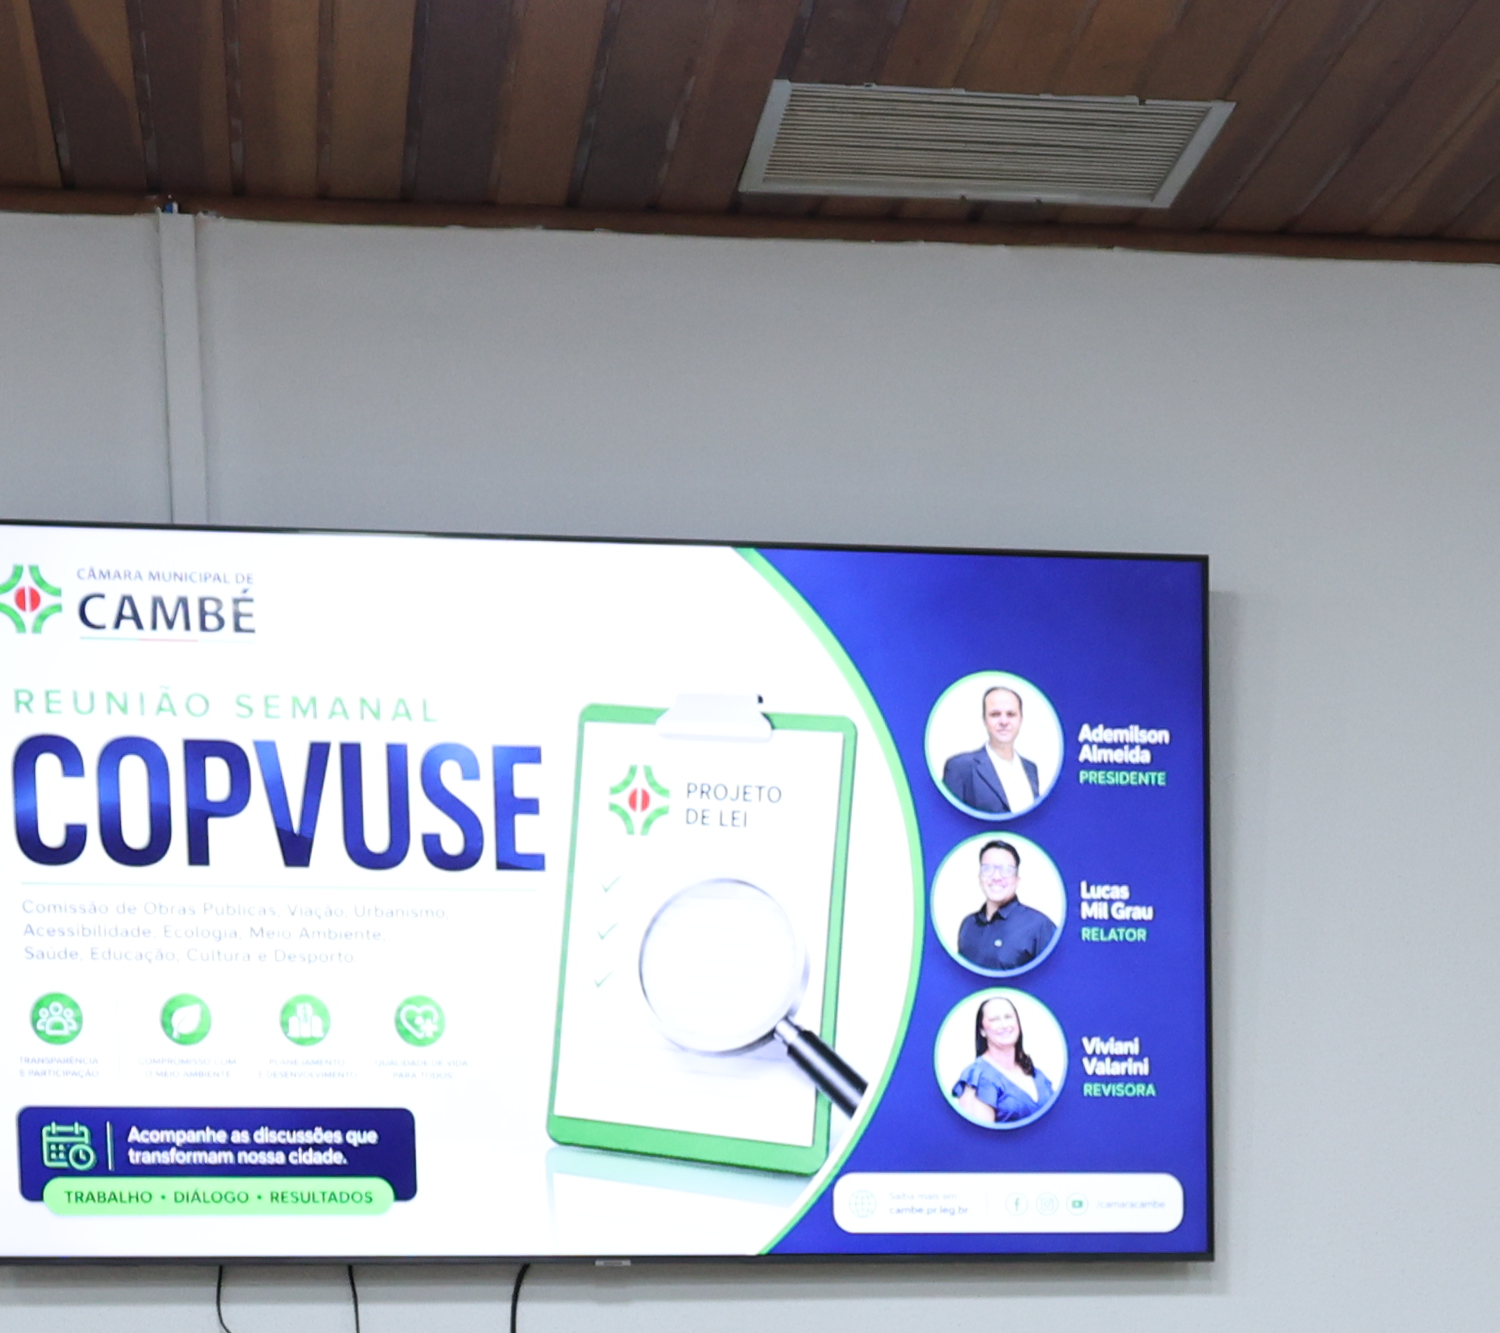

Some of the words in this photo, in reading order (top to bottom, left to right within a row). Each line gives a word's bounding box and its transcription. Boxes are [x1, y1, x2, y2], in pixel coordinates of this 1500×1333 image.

[77, 567, 143, 581] CÂMARA
[149, 571, 228, 583] MUNICIPAL
[236, 573, 253, 584] DE
[78, 589, 255, 633] CAMBÉ
[13, 685, 210, 718] REUNIÃO
[235, 694, 436, 722] SEMANAL
[1078, 723, 1170, 744] Ademilson
[1078, 744, 1151, 764] Almeida
[1079, 770, 1166, 786] PRESIDENTE
[687, 783, 782, 803] PROJETO
[12, 734, 545, 872] COPVUSE
[686, 808, 709, 825] DE
[720, 810, 747, 827] LEI
[1080, 881, 1130, 900] Lucas
[116, 902, 137, 914] de
[144, 902, 195, 915] Obras
[1081, 901, 1109, 920] Mil
[1110, 901, 1154, 920] Grau
[1081, 927, 1148, 942] RELATOR
[187, 948, 250, 961] Cultura
[257, 952, 268, 963] e
[1082, 1037, 1140, 1056] Viviani
[1082, 1057, 1149, 1075] Valarini
[1083, 1082, 1157, 1097] REVISORA
[128, 1126, 228, 1147] Acompanhe
[231, 1130, 251, 1144] as
[253, 1126, 343, 1145] discussões
[346, 1130, 378, 1147] que
[128, 1146, 234, 1165] transformam
[237, 1151, 286, 1165] nossa
[288, 1147, 348, 1165] cidade.
[65, 1191, 152, 1203] TRABALHO
[174, 1189, 249, 1204] DIÁLOGO
[270, 1191, 373, 1204] RESULTADOS
